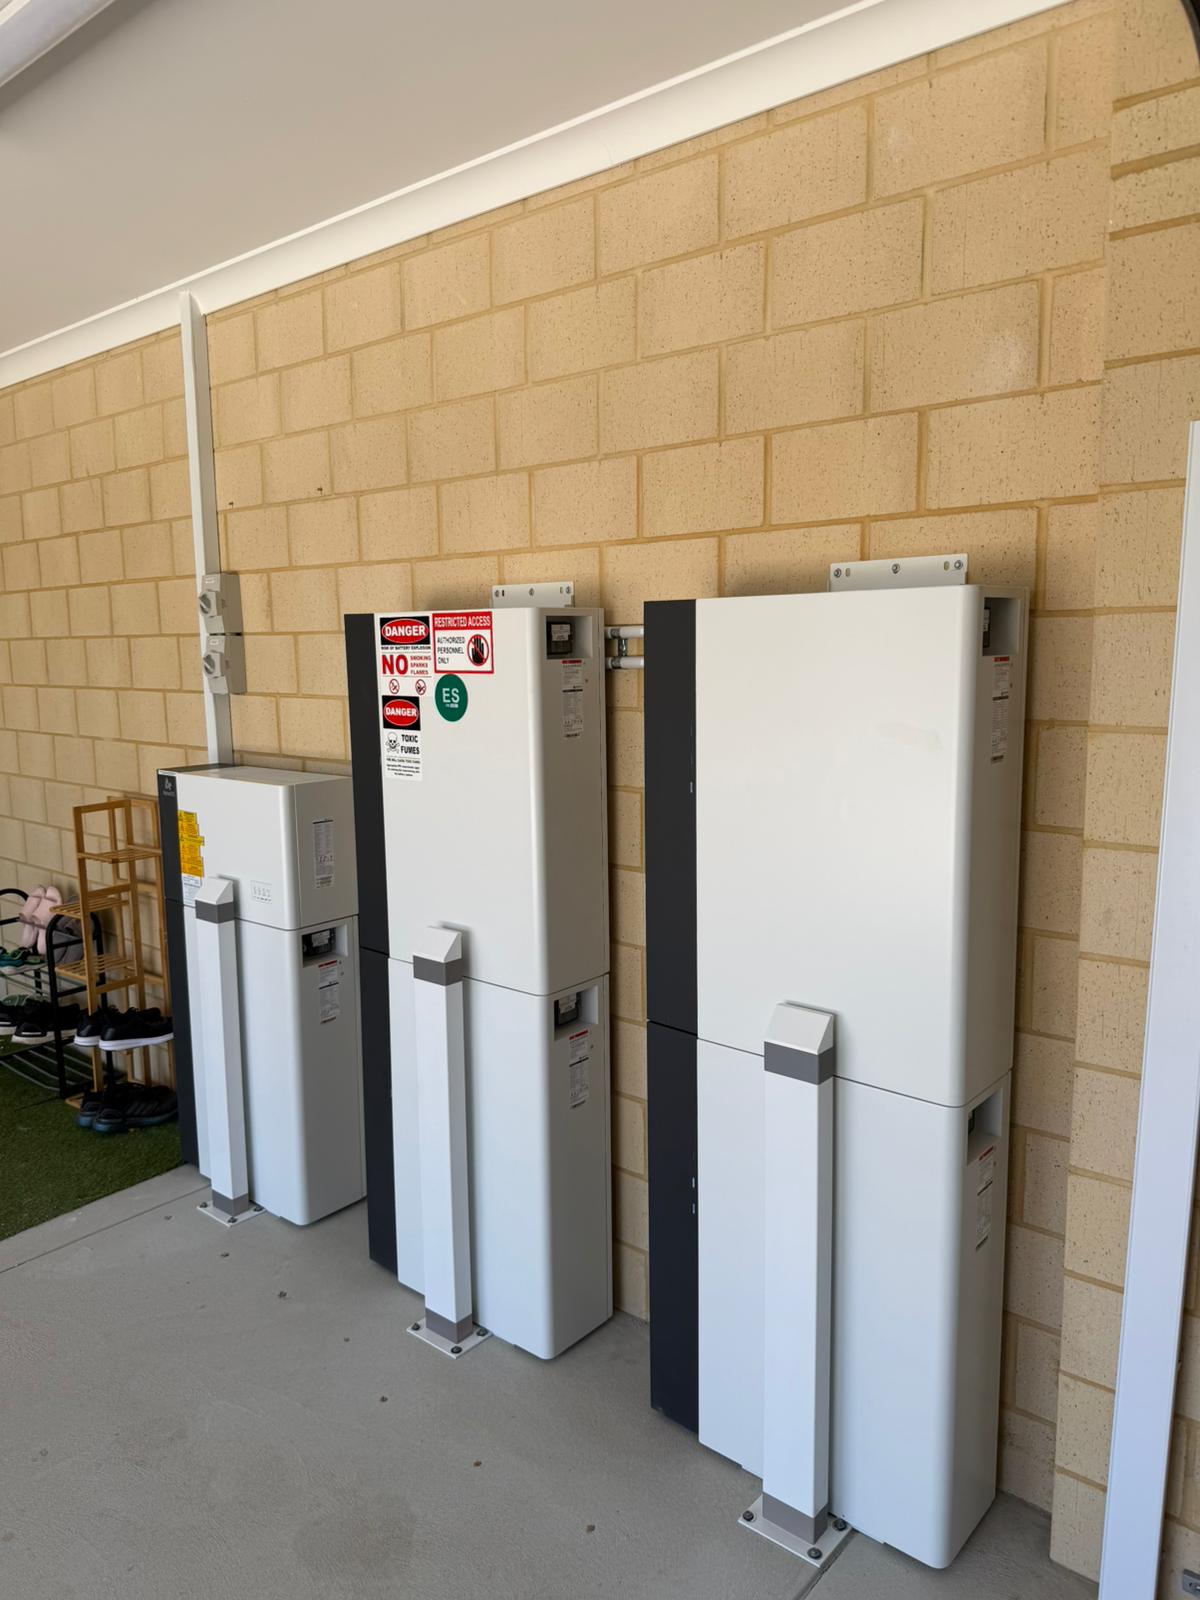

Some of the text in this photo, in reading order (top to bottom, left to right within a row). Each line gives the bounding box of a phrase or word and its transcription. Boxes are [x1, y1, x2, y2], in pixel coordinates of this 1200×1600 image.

[434, 615, 491, 628] RESTRICTED ACCESS
[385, 625, 426, 637] DANGER
[437, 646, 465, 655] PERSONNEL
[381, 654, 409, 675] NO
[437, 656, 450, 665] ONLY
[442, 687, 460, 703] ES
[385, 707, 418, 717] DANGER
[401, 734, 418, 743] TOXIC
[400, 746, 420, 755] FUMES
